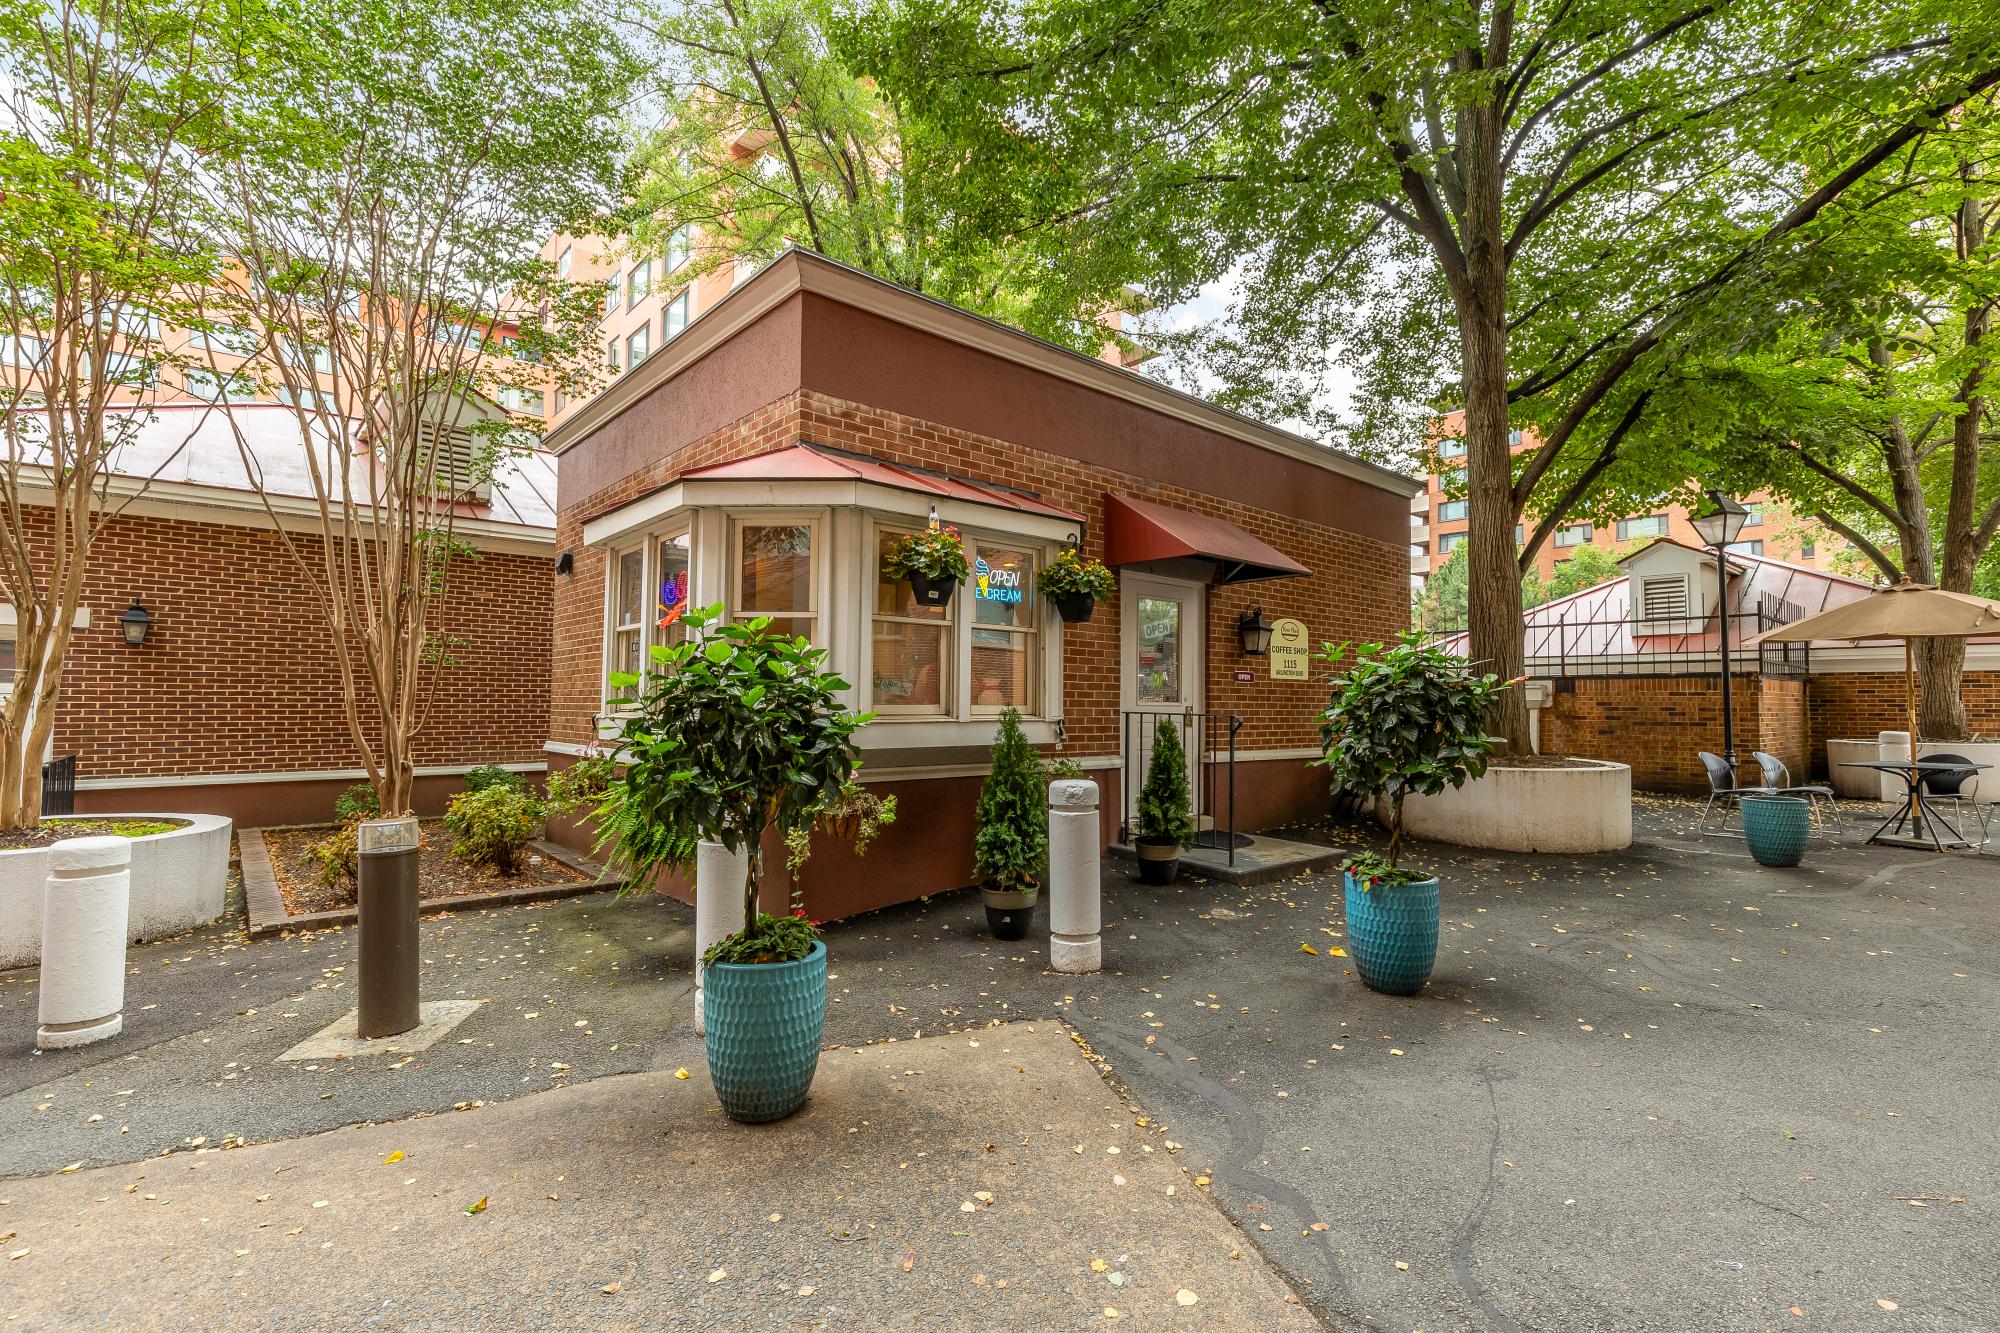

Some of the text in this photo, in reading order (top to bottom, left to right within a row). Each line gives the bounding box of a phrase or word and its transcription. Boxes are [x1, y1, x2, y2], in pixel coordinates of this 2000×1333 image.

[990, 570, 1020, 586] OPEN
[987, 588, 1022, 602] CREAM
[1145, 622, 1168, 637] OPEN
[1272, 646, 1307, 655] COFFEE SHOP
[1284, 660, 1297, 668] 1115
